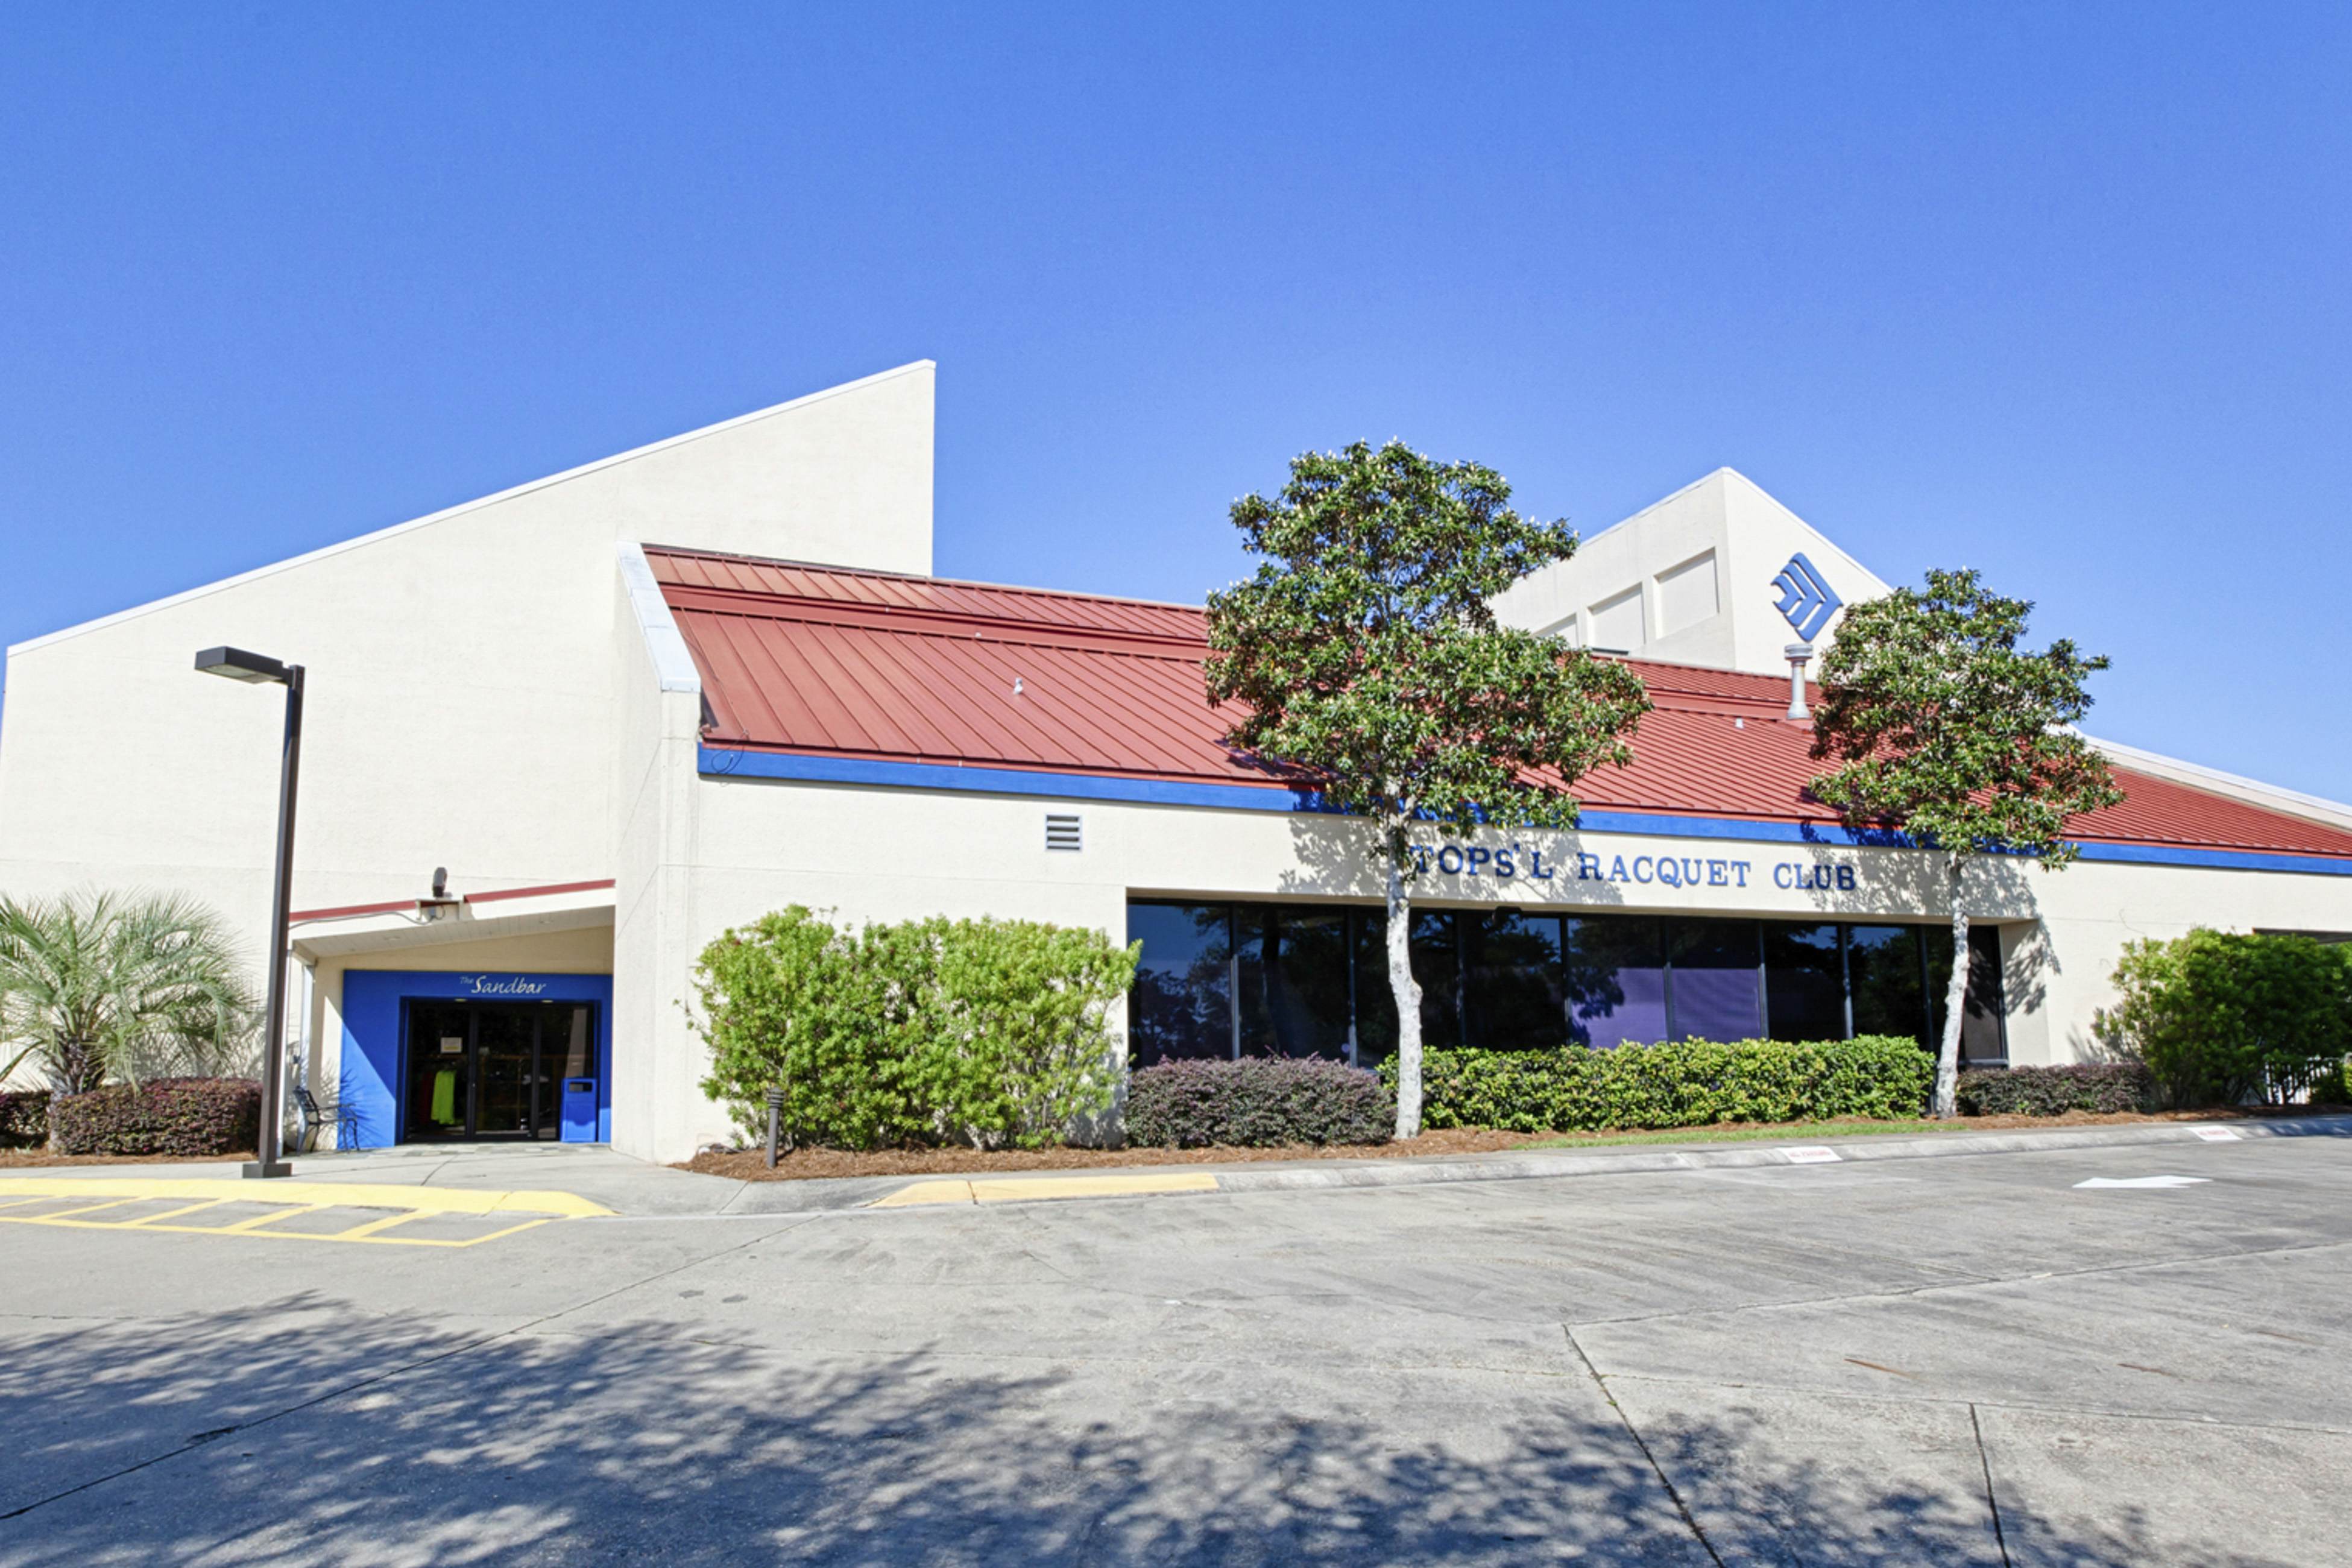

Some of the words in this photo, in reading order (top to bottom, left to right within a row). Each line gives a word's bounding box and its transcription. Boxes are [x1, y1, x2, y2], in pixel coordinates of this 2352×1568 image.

[1409, 843, 1554, 879] TOPS'L
[1577, 852, 1751, 889] RACQUET
[1773, 863, 1856, 891] CLUB
[459, 975, 474, 984] The
[471, 975, 547, 994] Sandbar
